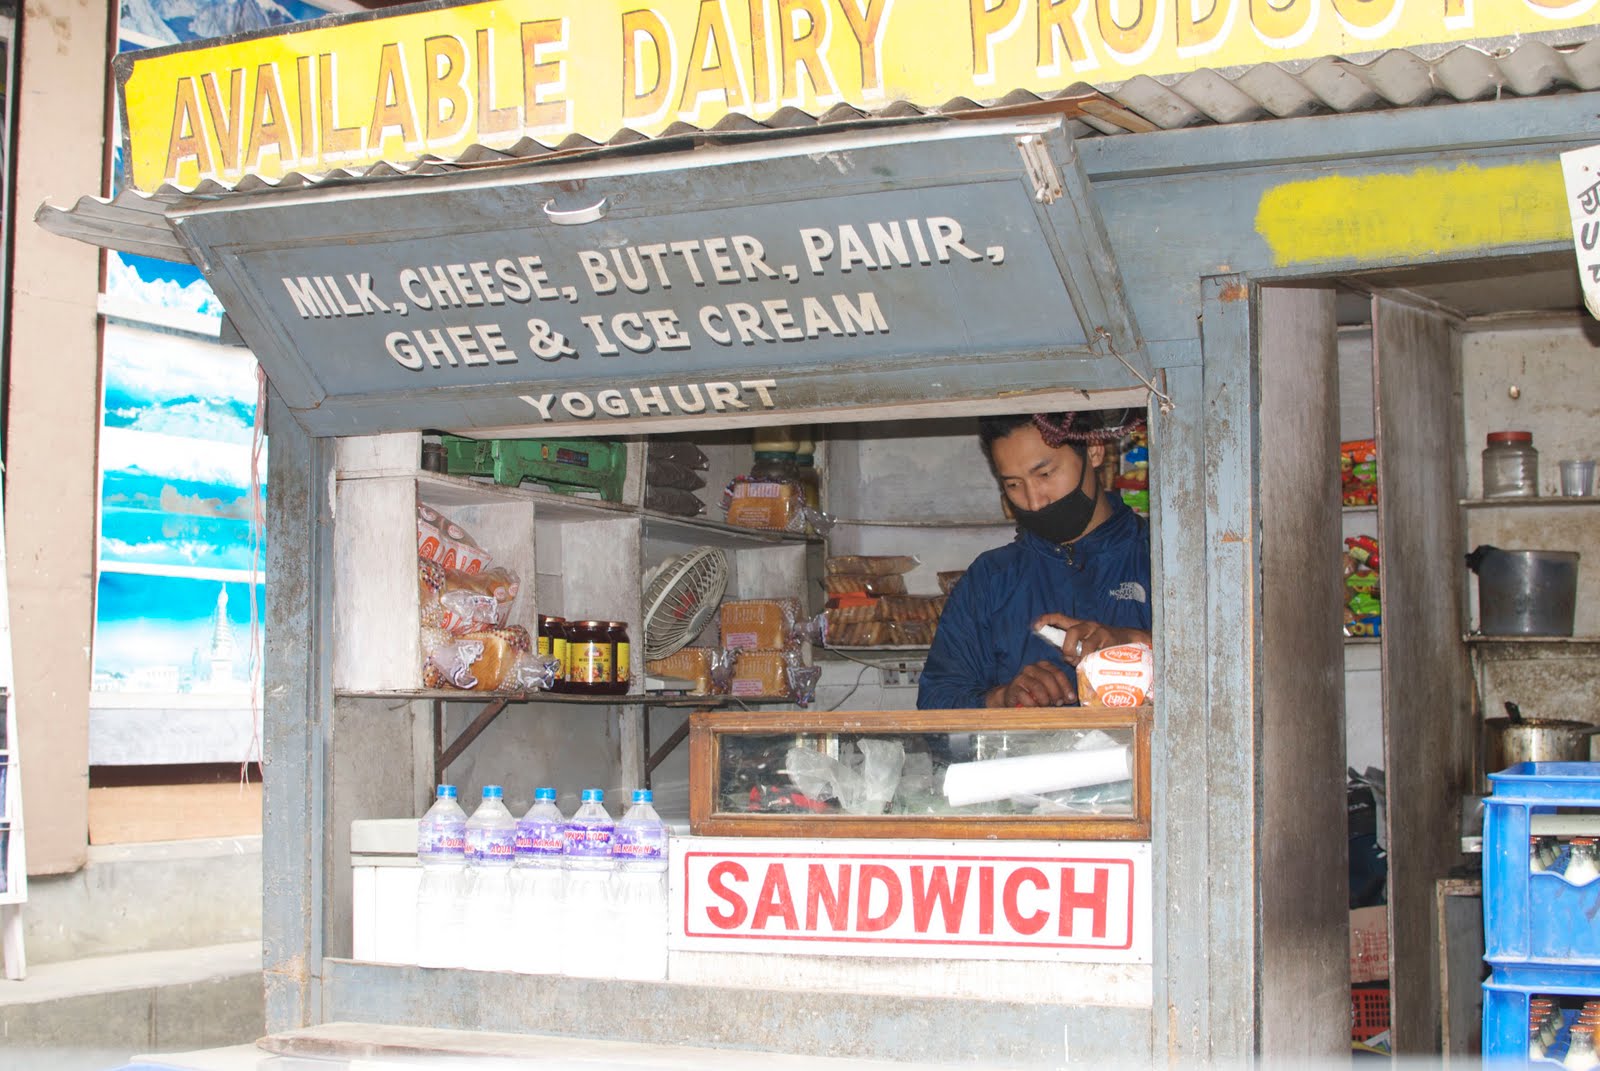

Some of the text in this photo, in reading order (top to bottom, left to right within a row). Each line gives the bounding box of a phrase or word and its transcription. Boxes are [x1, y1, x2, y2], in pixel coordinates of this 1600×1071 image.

[165, 0, 1600, 179] AVAILABLE DAIRY PROD
[577, 234, 800, 294] BUTTER,
[800, 216, 1005, 275] PANIR,
[385, 292, 890, 371] GHEE & ICE CREAM
[518, 378, 777, 421] YOGHURT
[705, 860, 1109, 938] SANDWICH
